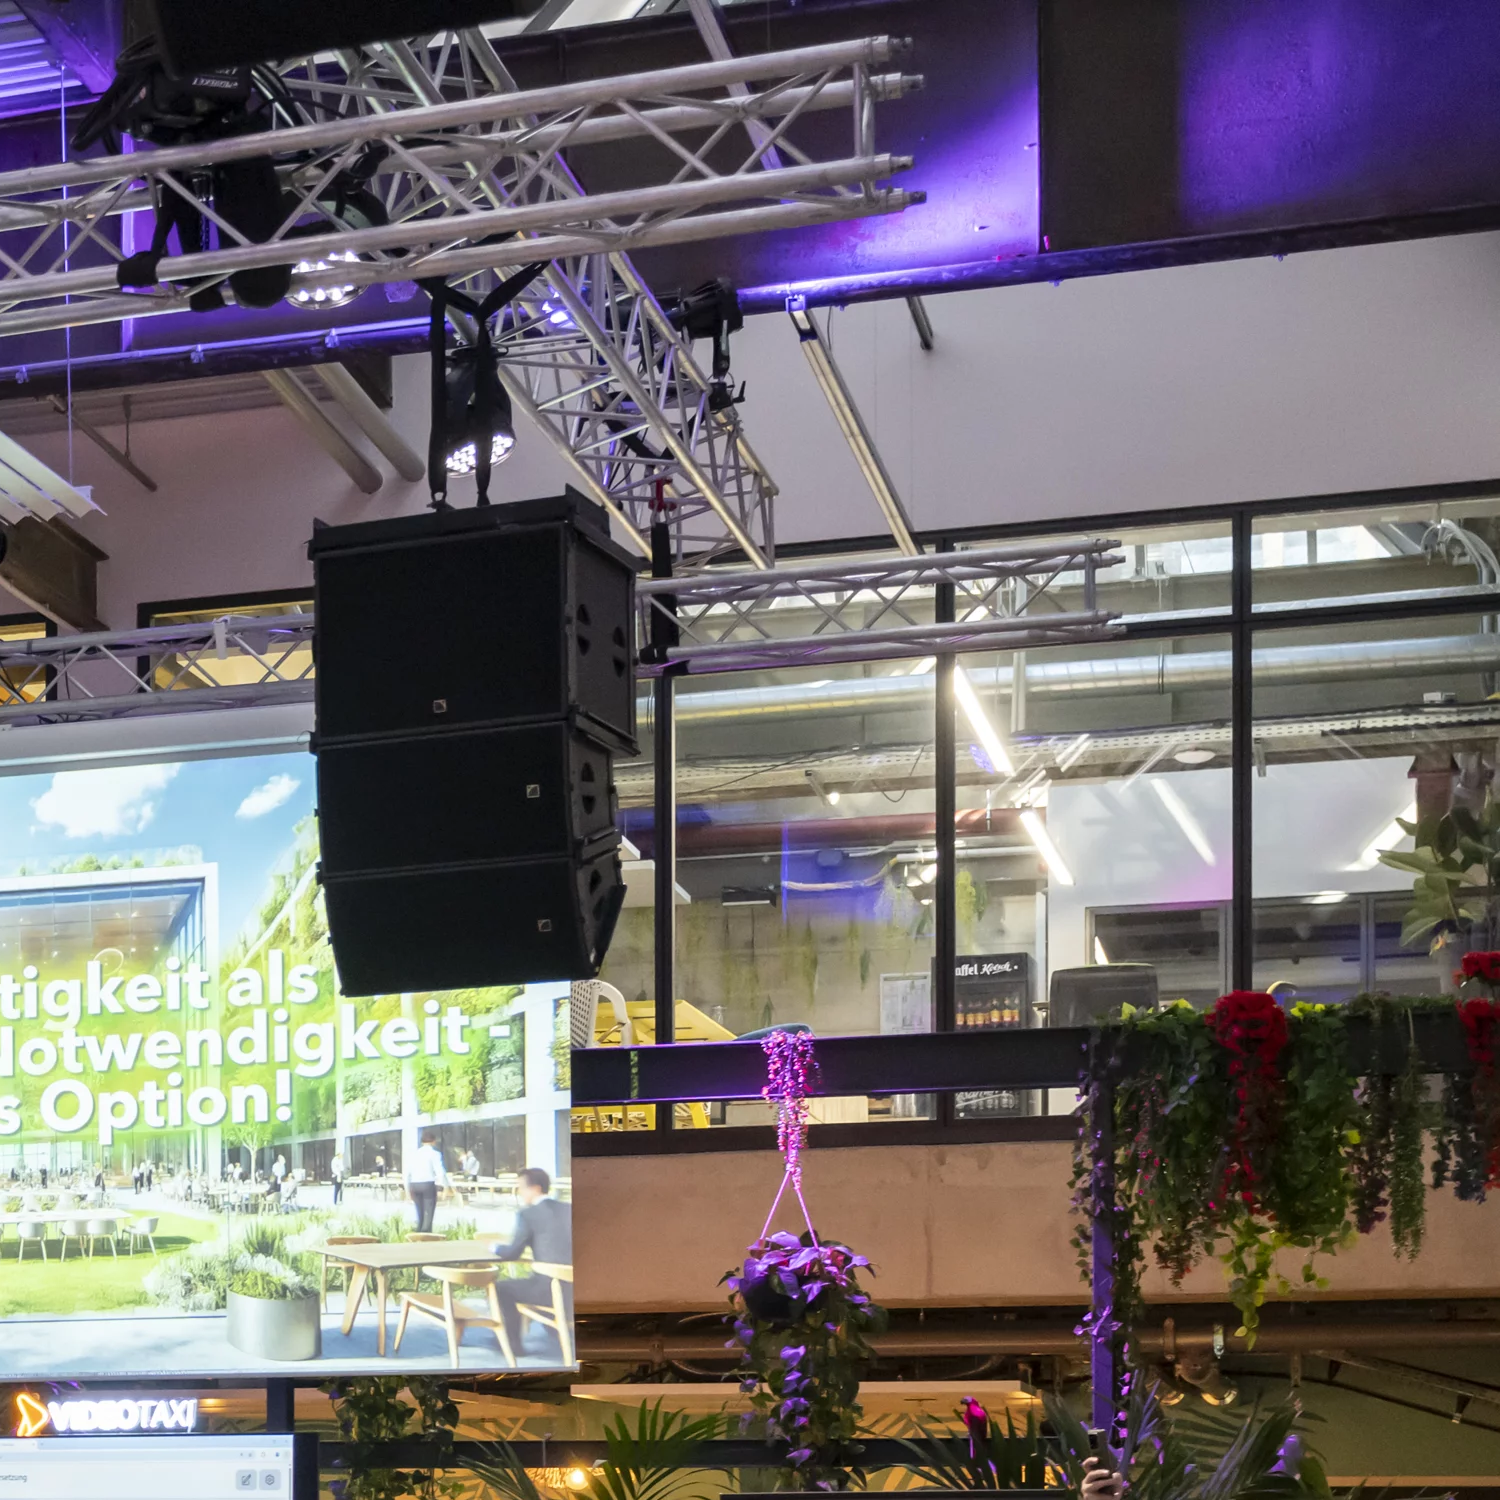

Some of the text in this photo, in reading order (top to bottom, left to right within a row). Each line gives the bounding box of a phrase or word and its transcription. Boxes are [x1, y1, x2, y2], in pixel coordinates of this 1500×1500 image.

[226, 951, 320, 1008] als
[954, 963, 979, 977] affel
[39, 1071, 294, 1145] Option!
